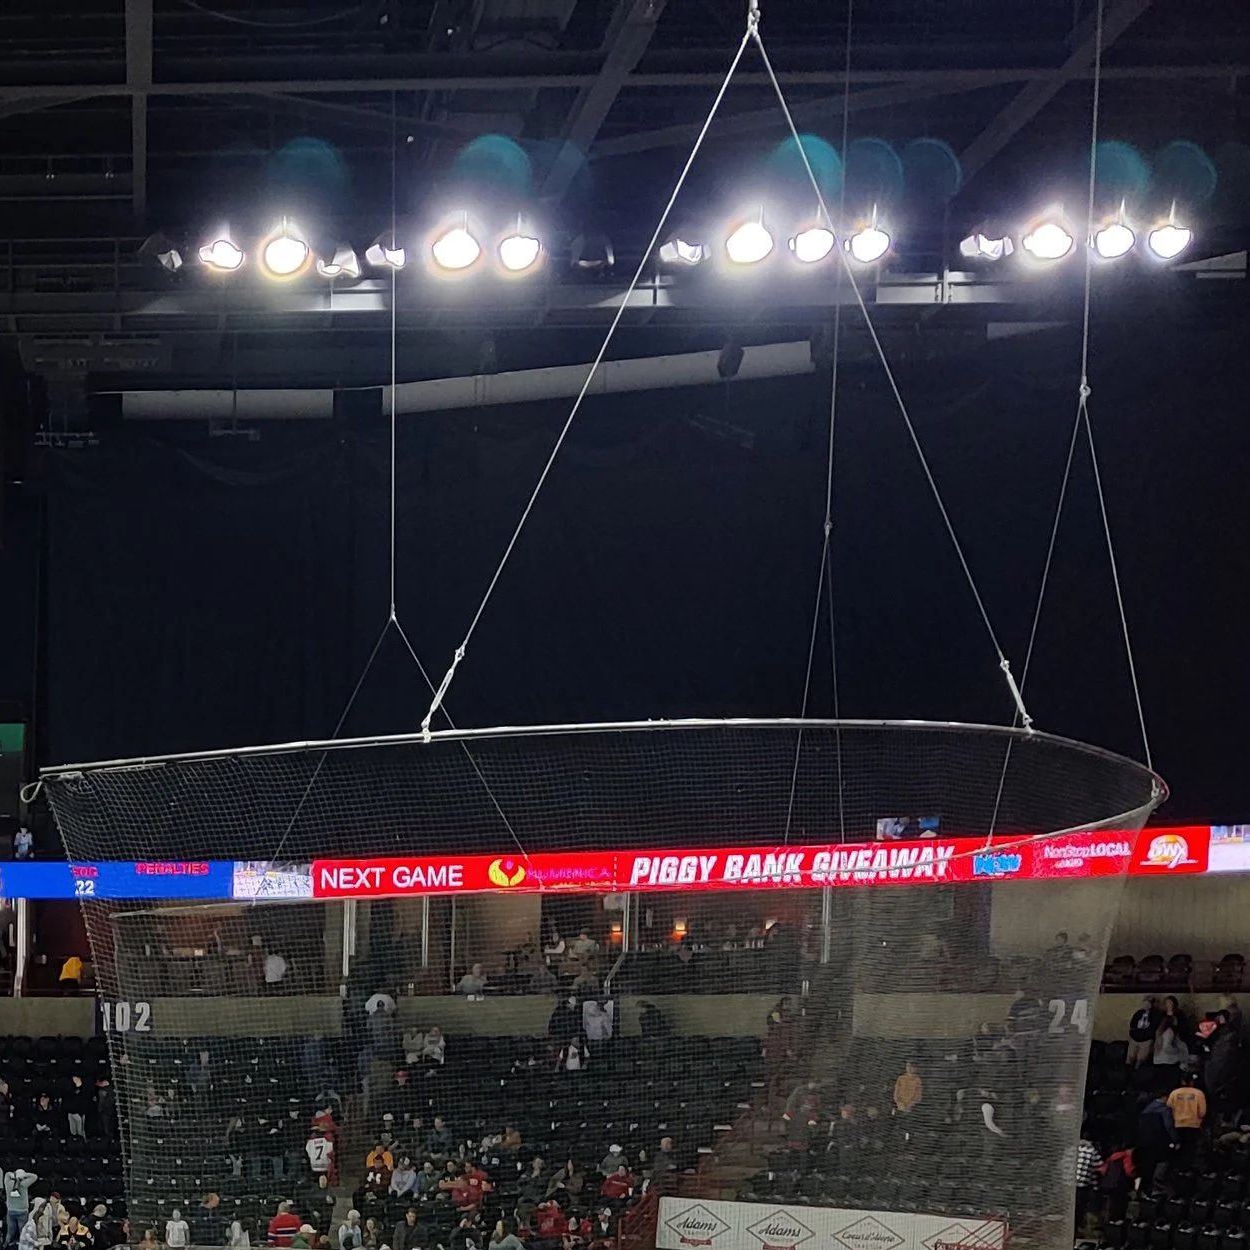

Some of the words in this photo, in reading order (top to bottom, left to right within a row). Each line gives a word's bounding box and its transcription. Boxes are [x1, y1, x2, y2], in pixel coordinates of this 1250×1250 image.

[135, 862, 209, 875] PENALTIES
[630, 855, 717, 886] PIGGY
[723, 852, 804, 884] BANK
[811, 845, 955, 882] GIVEAWAY
[320, 867, 386, 889] NEXT
[392, 865, 464, 888] GAME
[75, 880, 95, 895] 22
[100, 1002, 151, 1031] 102
[314, 1145, 324, 1161] 7
[676, 1216, 718, 1232] Adams
[758, 1223, 802, 1238] Adams
